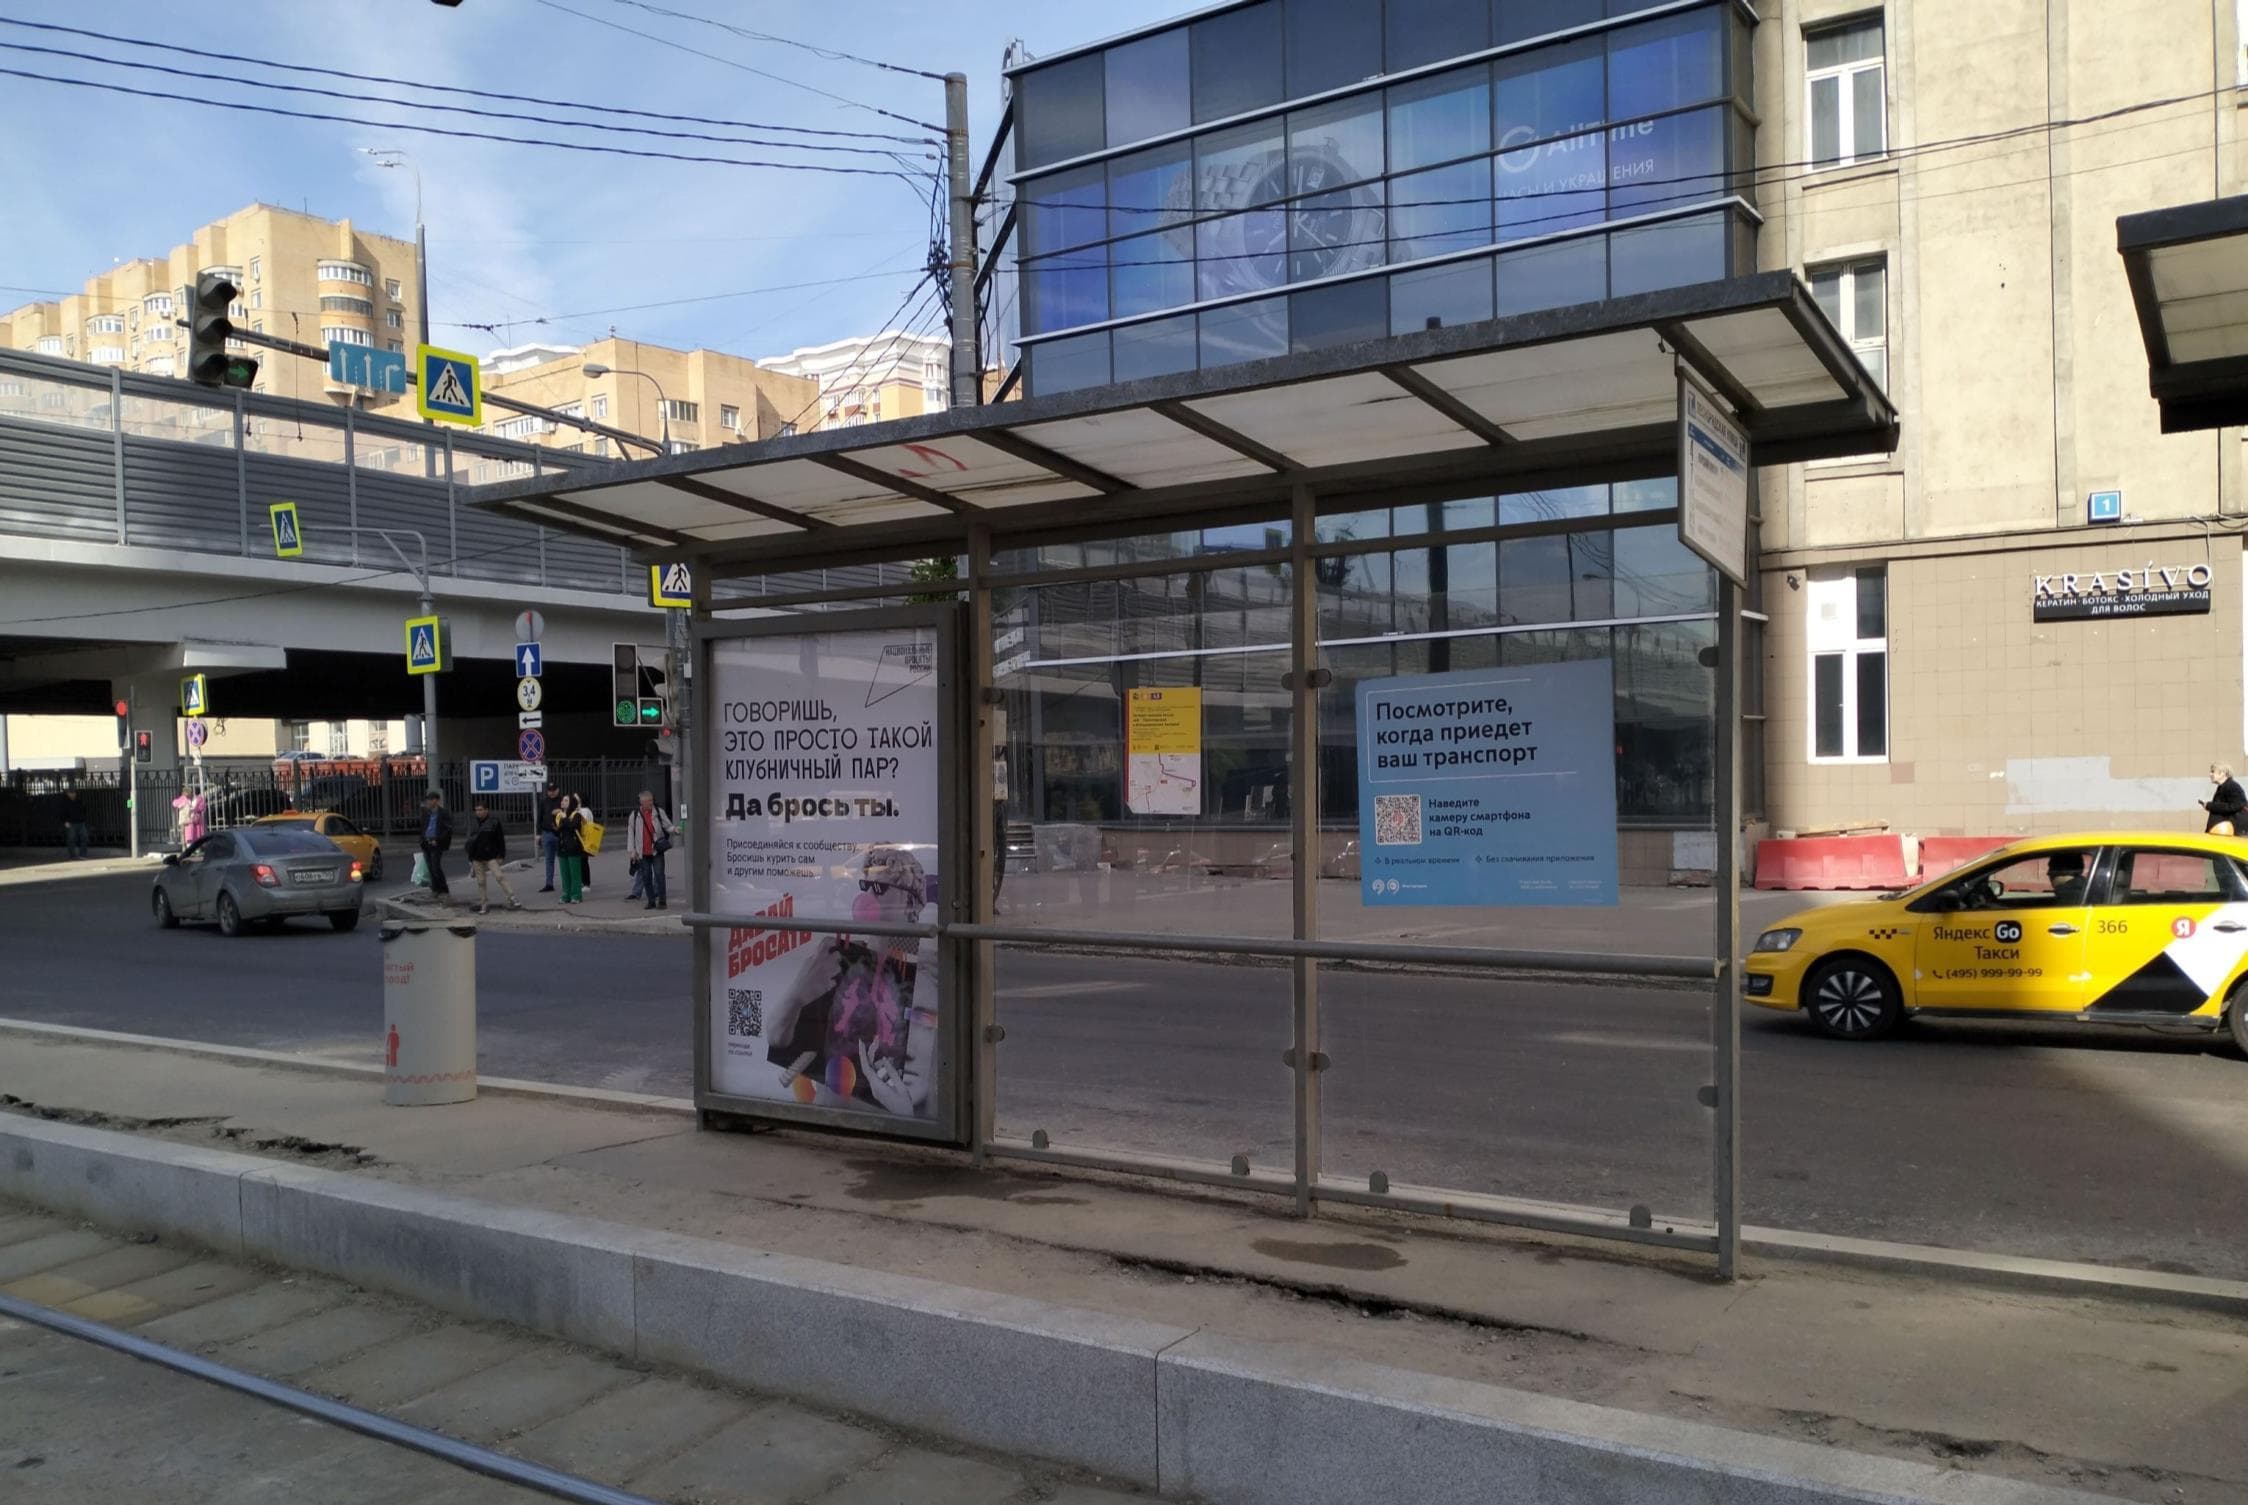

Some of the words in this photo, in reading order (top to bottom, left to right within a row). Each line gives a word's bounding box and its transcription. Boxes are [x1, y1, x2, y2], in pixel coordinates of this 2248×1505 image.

[2102, 498, 2111, 512] 1
[2036, 599, 2077, 608] КЕРАТИН
[2083, 596, 2119, 605] БОТОКС
[2125, 590, 2181, 603] ХОЛОДНЫЙ
[2183, 591, 2209, 600] УХОД
[2092, 606, 2111, 615] ДЛЯ
[2114, 604, 2146, 613] ВОЛОС
[523, 684, 536, 697] 3,4
[725, 699, 838, 723] ГОВОРИШЬ,
[1376, 698, 1513, 721] Посмотрите,
[724, 730, 765, 751] ЭТО
[774, 728, 858, 751] ПРОСТО
[867, 721, 932, 749] ТАКОЙ
[1377, 728, 1434, 746] когда
[1441, 721, 1533, 745] приедет
[1378, 753, 1418, 768] ваш
[1423, 746, 1538, 770] транспорт
[852, 757, 900, 779] ПАР?
[481, 767, 494, 787] P
[726, 793, 762, 820] Да
[767, 792, 850, 823] брось
[854, 797, 900, 817] ты.
[1429, 799, 1480, 808] Наведите
[1429, 813, 1468, 823] камеру
[1470, 810, 1531, 822] смартфона
[1430, 828, 1442, 836] на
[1444, 826, 1483, 837] QR-код
[727, 839, 794, 850] Присоединяйся
[727, 851, 765, 863] Бросишь
[767, 855, 796, 865] курить
[799, 855, 815, 864] сам
[1486, 855, 1499, 863] Без
[734, 867, 764, 877] другим
[1933, 926, 1991, 942] Яндекс
[1996, 924, 2020, 939] Go
[2097, 920, 2128, 934] 366
[2176, 918, 2191, 937] Я
[1974, 945, 2020, 960] Такси
[1946, 968, 1978, 979] (495)
[1981, 968, 2043, 977] 999-99-99
